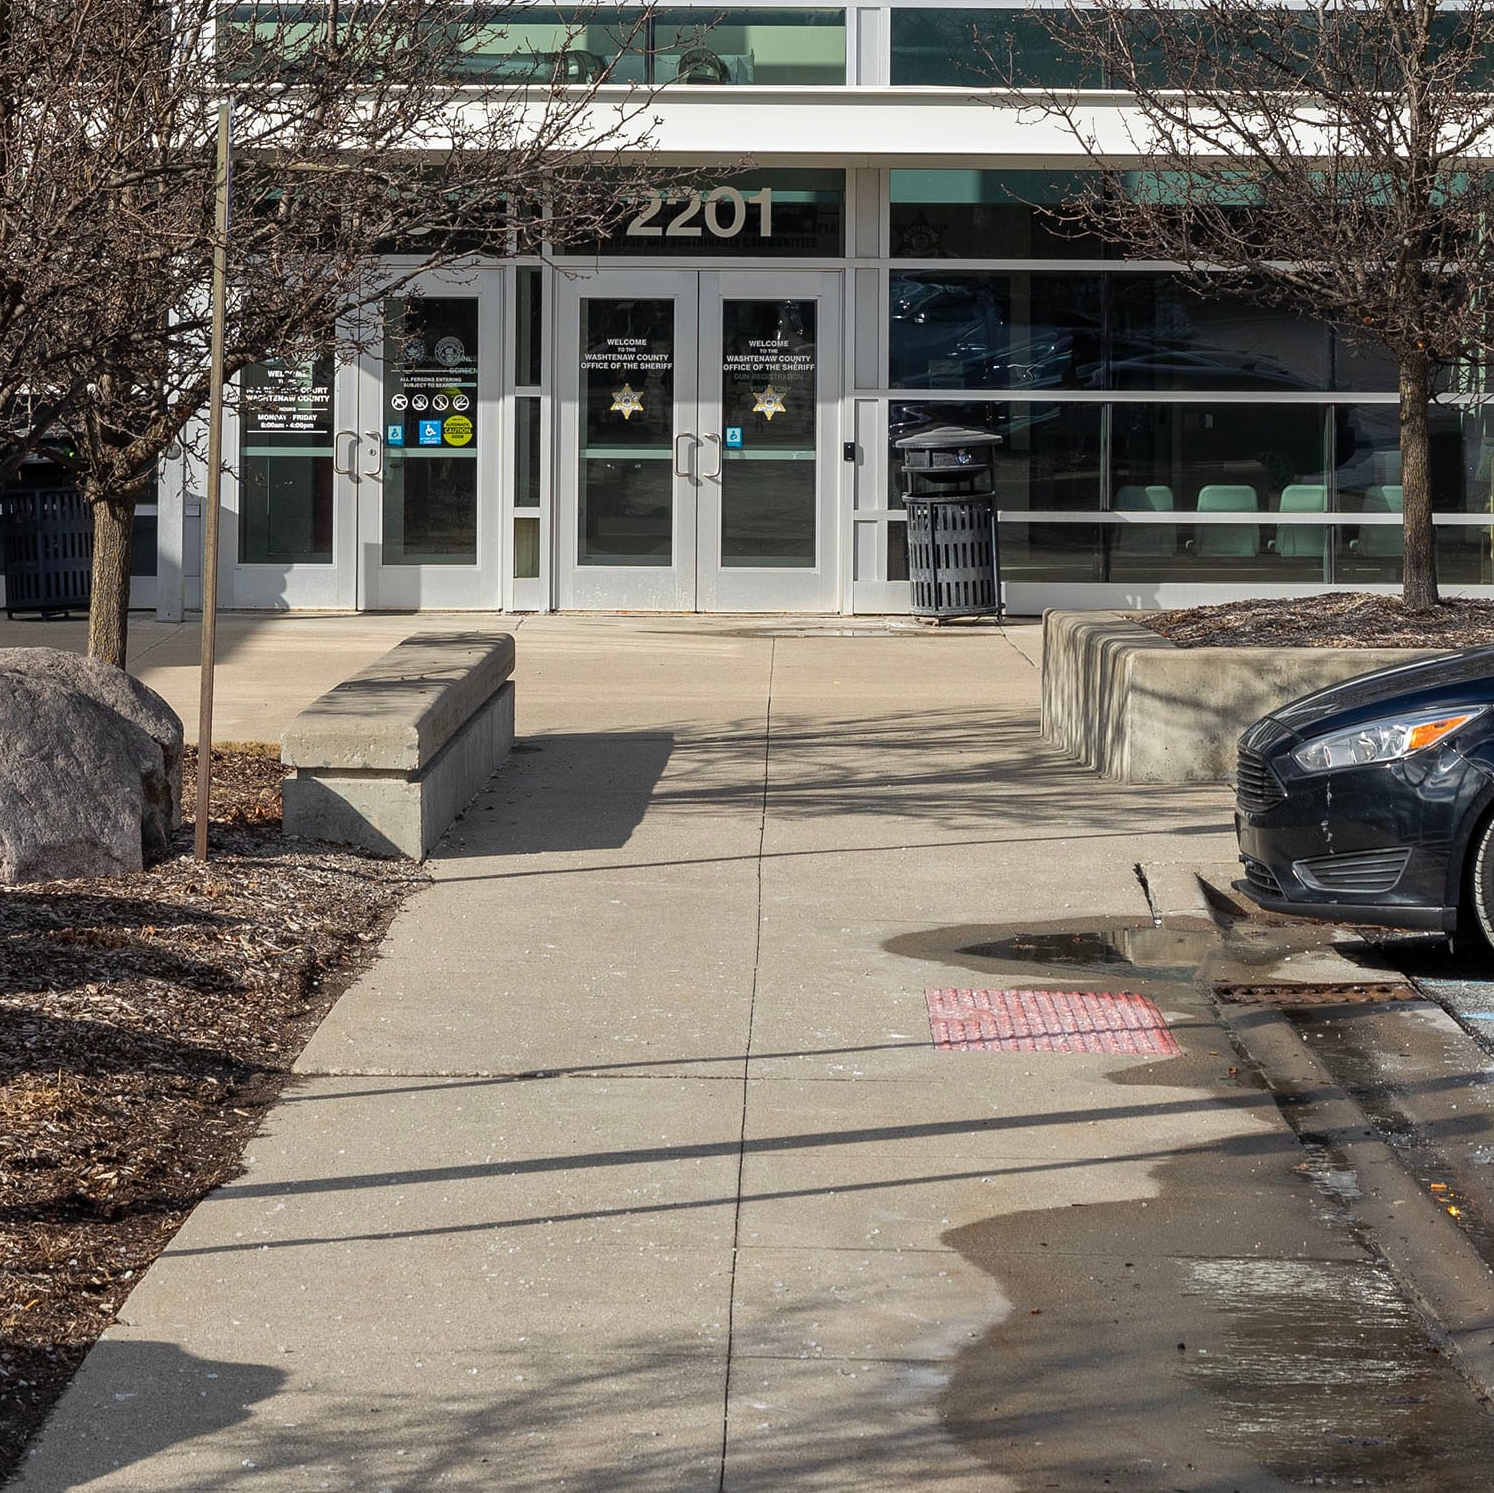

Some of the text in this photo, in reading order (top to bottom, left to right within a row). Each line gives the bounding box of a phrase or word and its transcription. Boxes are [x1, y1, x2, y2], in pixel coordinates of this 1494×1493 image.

[626, 185, 772, 238] 2201
[607, 338, 647, 346] WELCOME
[778, 355, 811, 363] COUNTY
[639, 362, 673, 370] SHERIFF
[782, 363, 815, 371] SHERIFF
